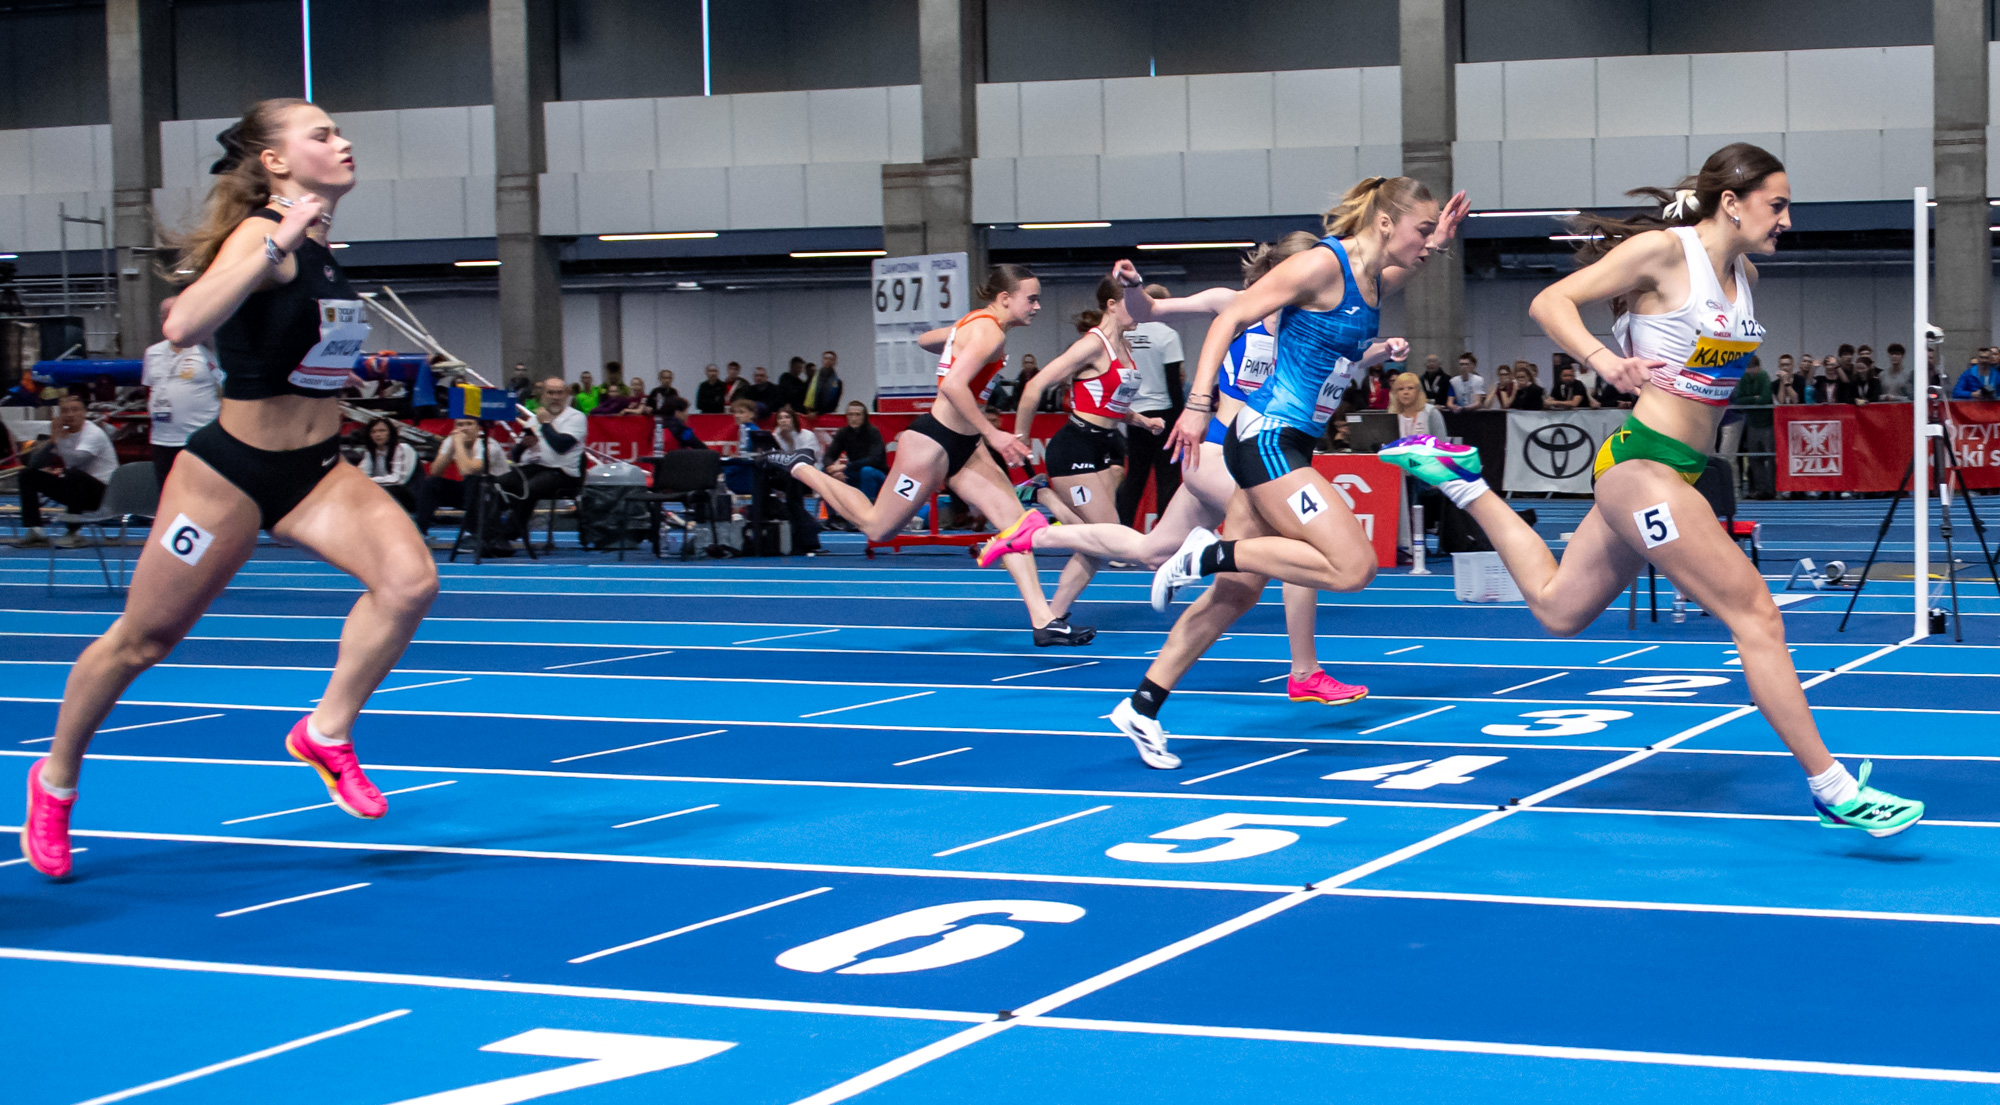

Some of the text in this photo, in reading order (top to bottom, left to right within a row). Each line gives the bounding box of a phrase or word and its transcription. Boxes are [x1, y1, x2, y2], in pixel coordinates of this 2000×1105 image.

[931, 260, 957, 270] PROBA
[875, 275, 951, 312] 697 3
[1685, 382, 1714, 396] DOLNY
[1793, 457, 1839, 474] PZLA
[898, 479, 914, 498] 2
[1077, 486, 1086, 503] 1
[1300, 490, 1318, 515] 4
[1644, 508, 1667, 542] 5
[171, 525, 200, 556] 6
[1587, 675, 1732, 697] 2
[1480, 708, 1635, 737] 3
[1319, 754, 1508, 790] 4
[1105, 811, 1348, 864] 5
[775, 899, 1087, 975] 6
[387, 1028, 740, 1105] 7
